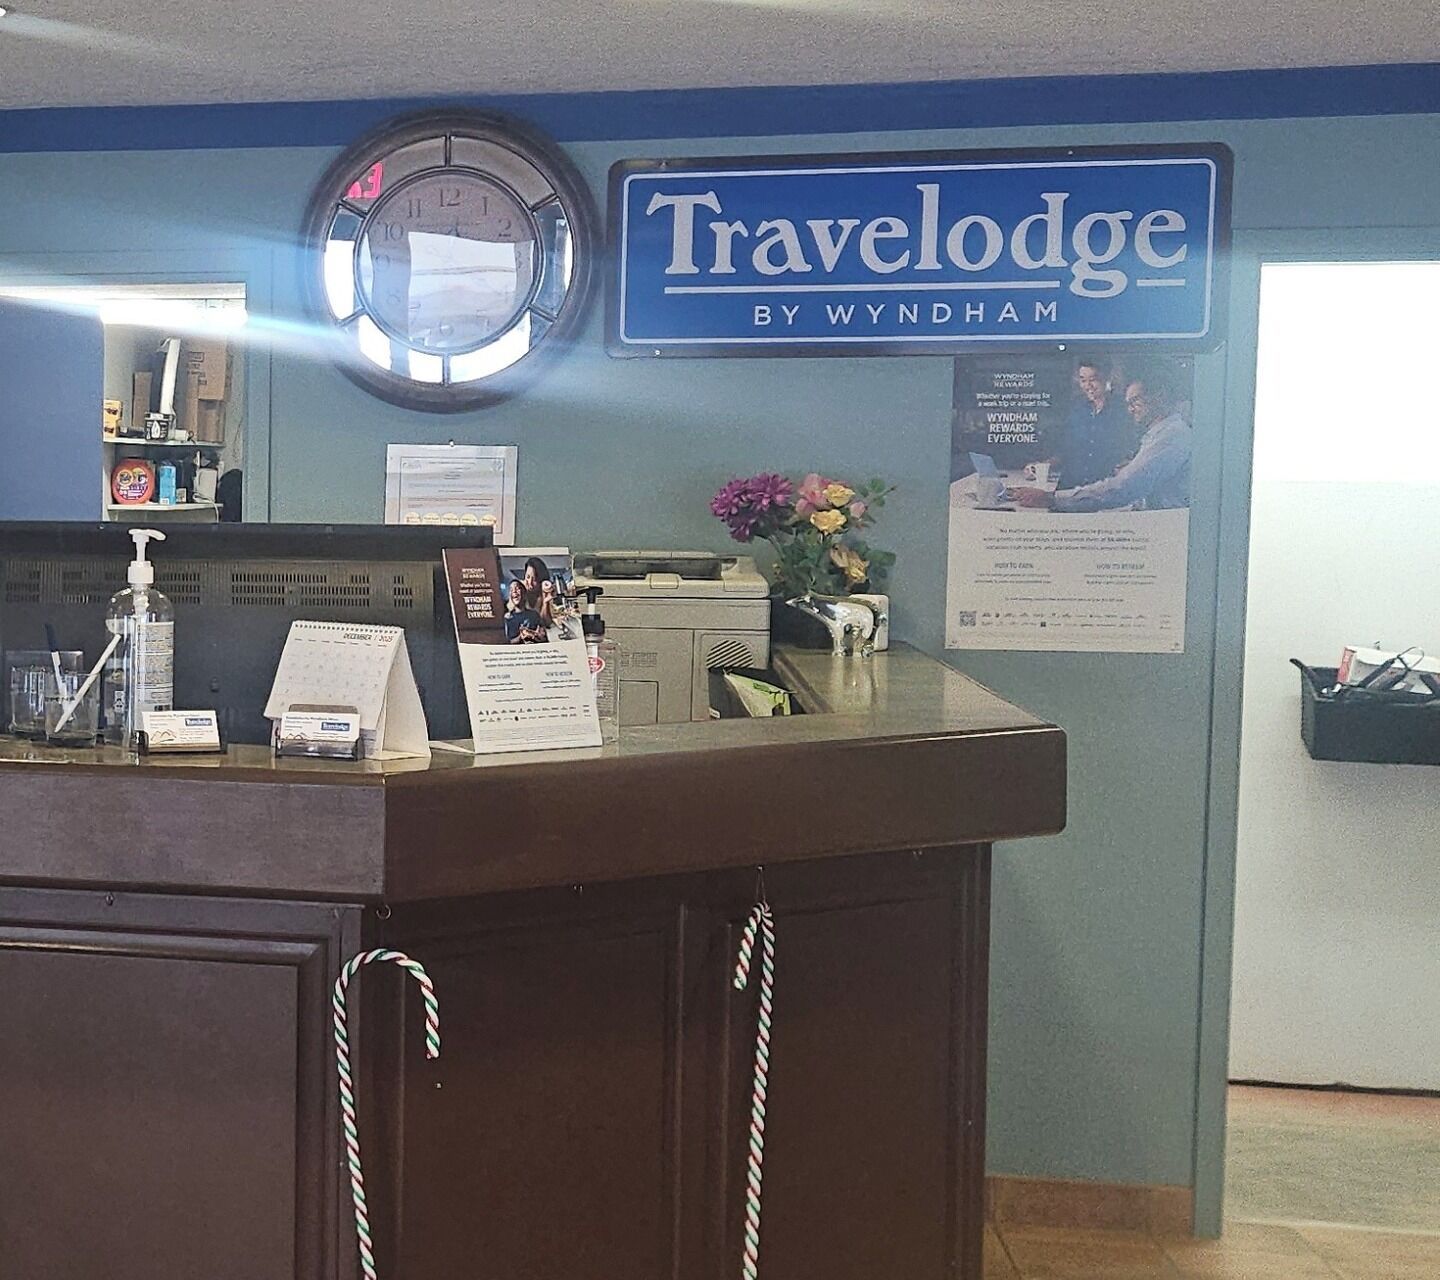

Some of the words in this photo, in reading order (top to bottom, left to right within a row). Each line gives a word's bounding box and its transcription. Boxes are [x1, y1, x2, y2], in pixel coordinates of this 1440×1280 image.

[645, 182, 1188, 299] Travelodge
[753, 304, 801, 327] BY
[827, 299, 1058, 325] WYNDHAM
[987, 412, 1038, 422] WYNDHAM
[989, 423, 1035, 433] REWARDS
[987, 433, 1039, 443] EVERYONE.
[343, 632, 373, 641] DECEMBER
